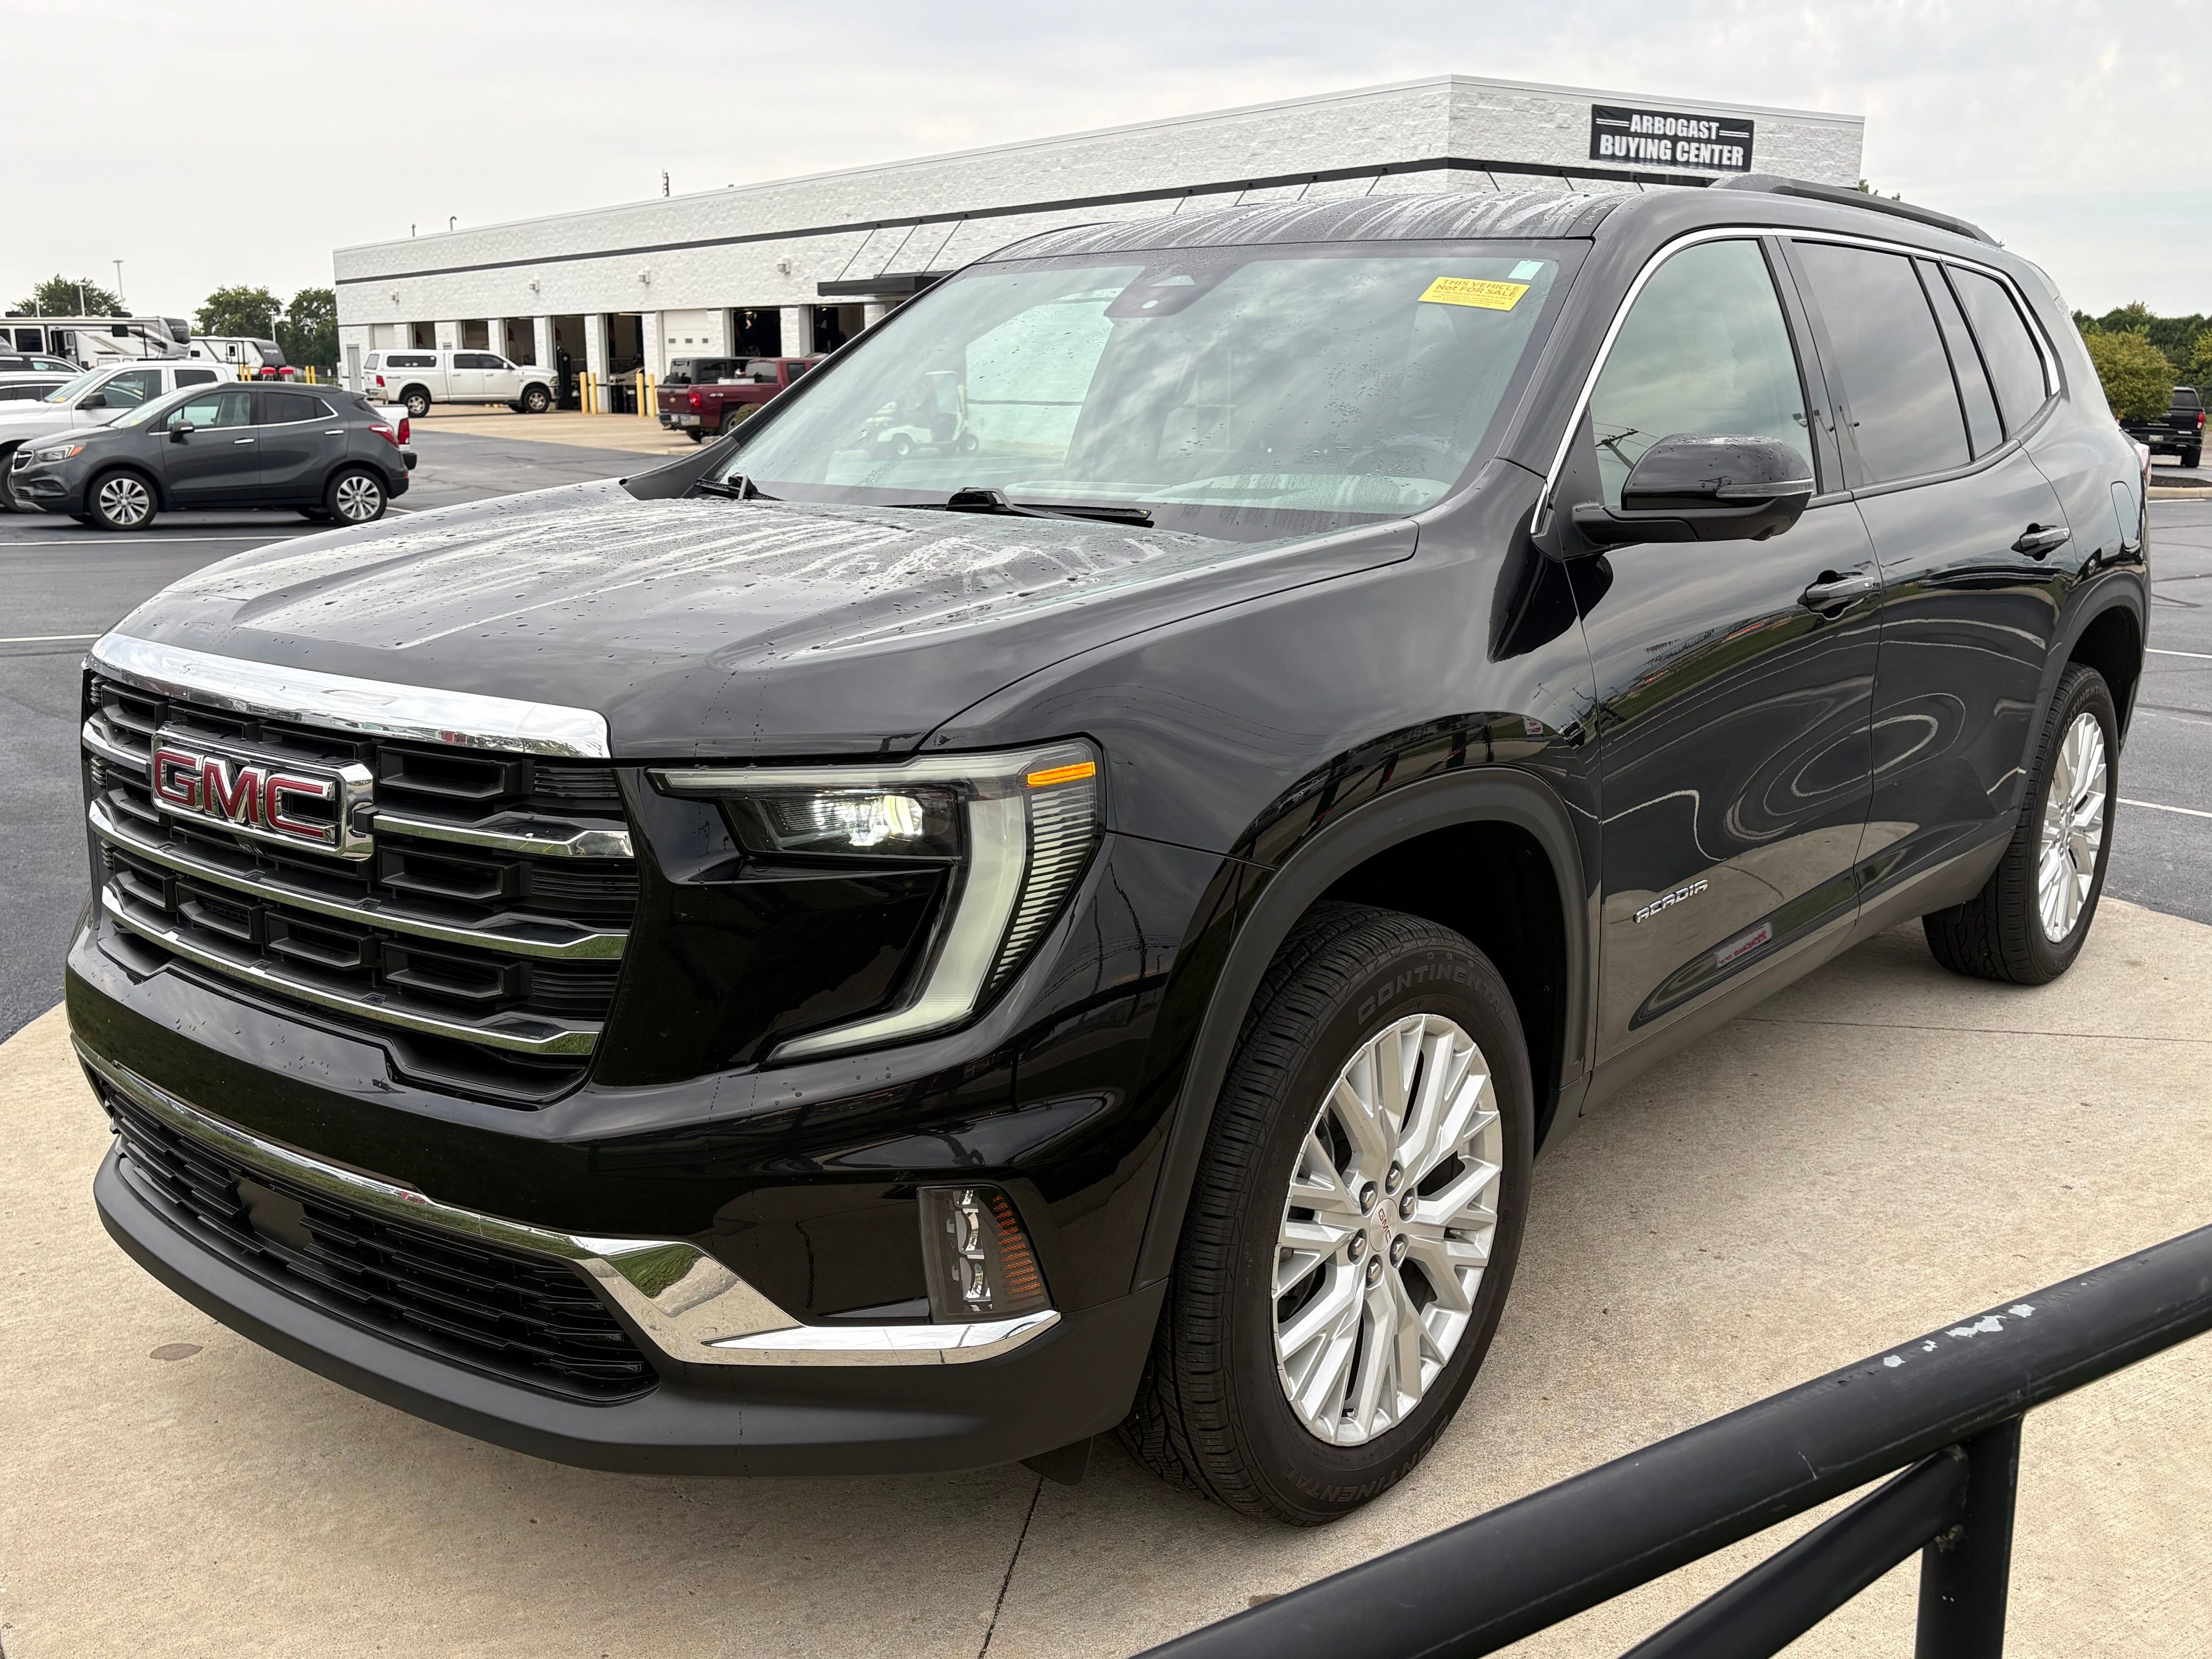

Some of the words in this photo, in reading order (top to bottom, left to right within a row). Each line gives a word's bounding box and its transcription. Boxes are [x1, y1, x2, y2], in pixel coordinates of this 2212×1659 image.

[1630, 114, 1719, 139] ARBOGAST
[1600, 134, 1672, 161] BUYING
[1676, 141, 1744, 166] CENTER
[1473, 282, 1521, 292] VEHICLE
[1486, 289, 1517, 297] SALE
[154, 747, 336, 844] GMC
[1633, 879, 1708, 923] ACADIA
[1357, 964, 1509, 1031] CONTINENTAL
[1378, 1208, 1392, 1244] GMC
